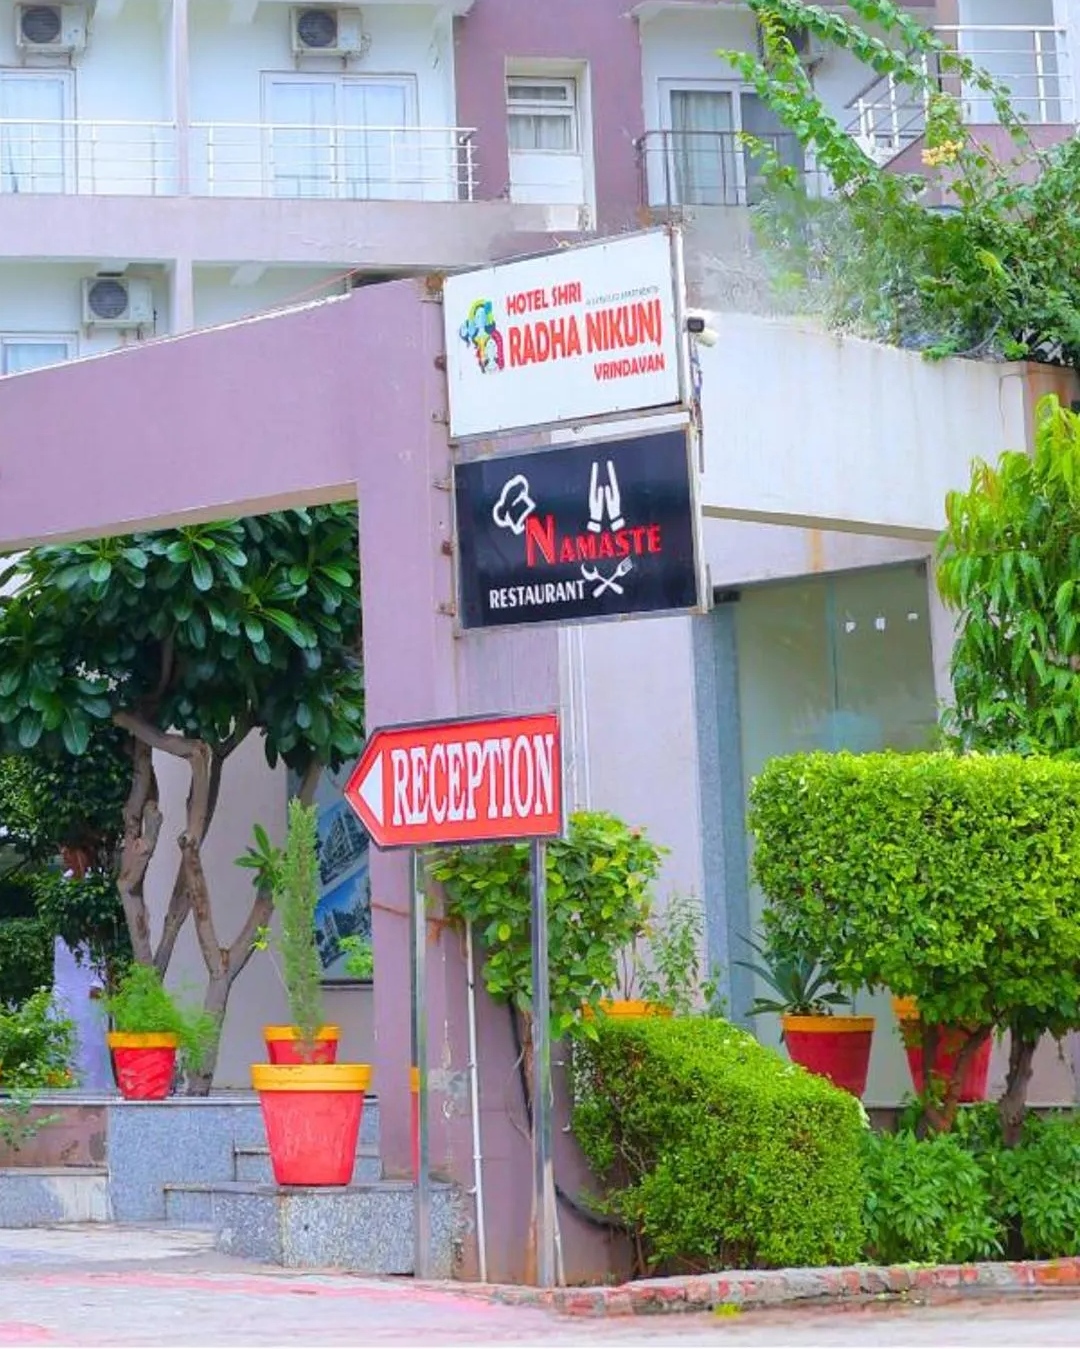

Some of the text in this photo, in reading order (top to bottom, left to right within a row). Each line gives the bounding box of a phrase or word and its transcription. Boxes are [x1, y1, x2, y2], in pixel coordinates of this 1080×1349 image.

[507, 289, 549, 315] HOTEL
[552, 282, 582, 307] SHRI
[509, 299, 662, 368] RADHA NIKUNJ
[593, 354, 665, 381] VRINDAVAN
[525, 513, 663, 568] NAMASTE
[489, 579, 587, 609] RESTAURANT
[391, 733, 555, 827] RECEPTION
